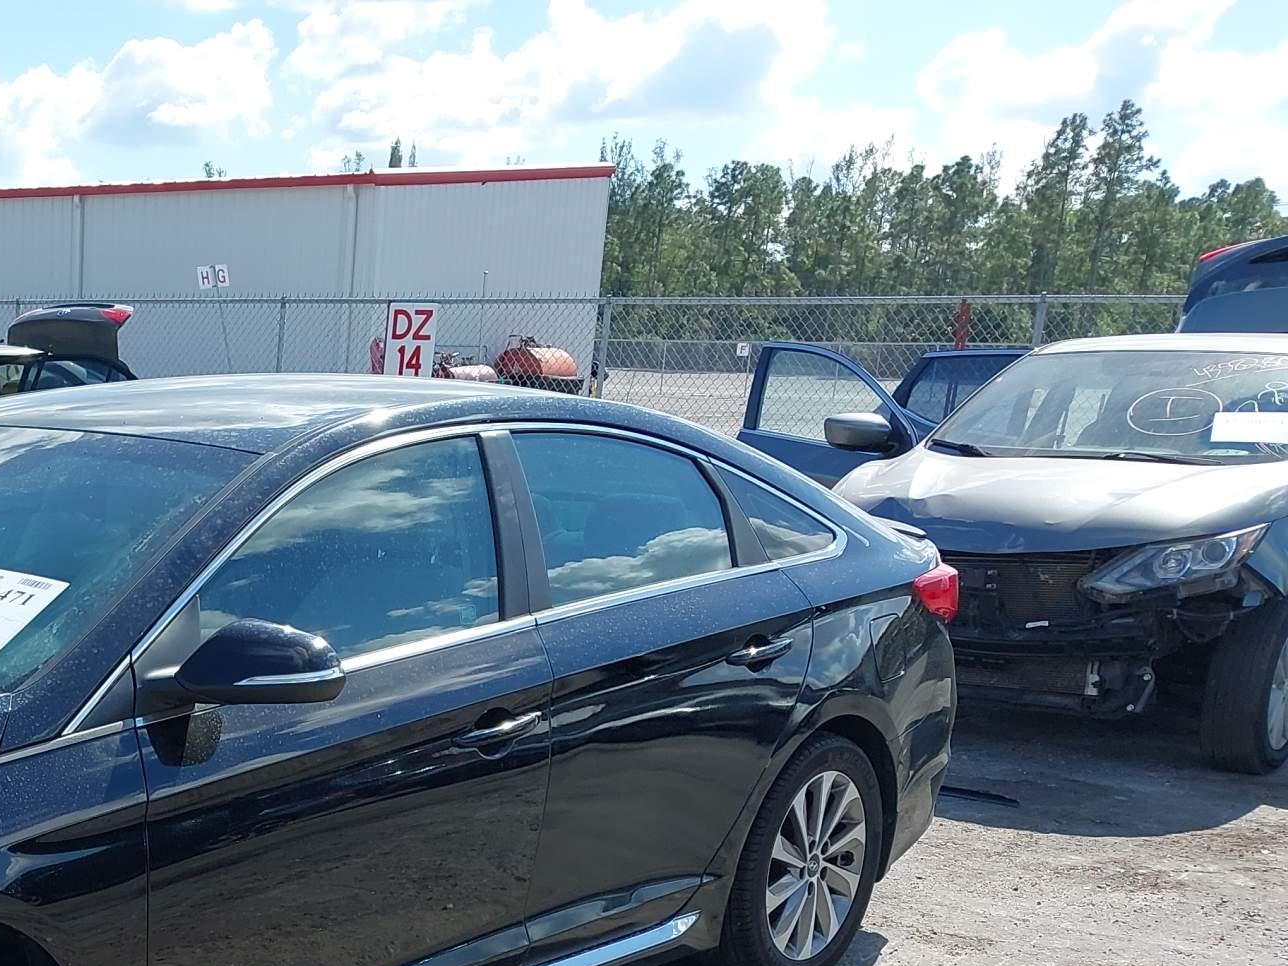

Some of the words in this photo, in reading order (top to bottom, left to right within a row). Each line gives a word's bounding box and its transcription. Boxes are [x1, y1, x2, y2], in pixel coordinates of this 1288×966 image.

[200, 270, 210, 285] H
[217, 269, 227, 284] G
[392, 309, 434, 341] DZ
[397, 345, 422, 377] 14
